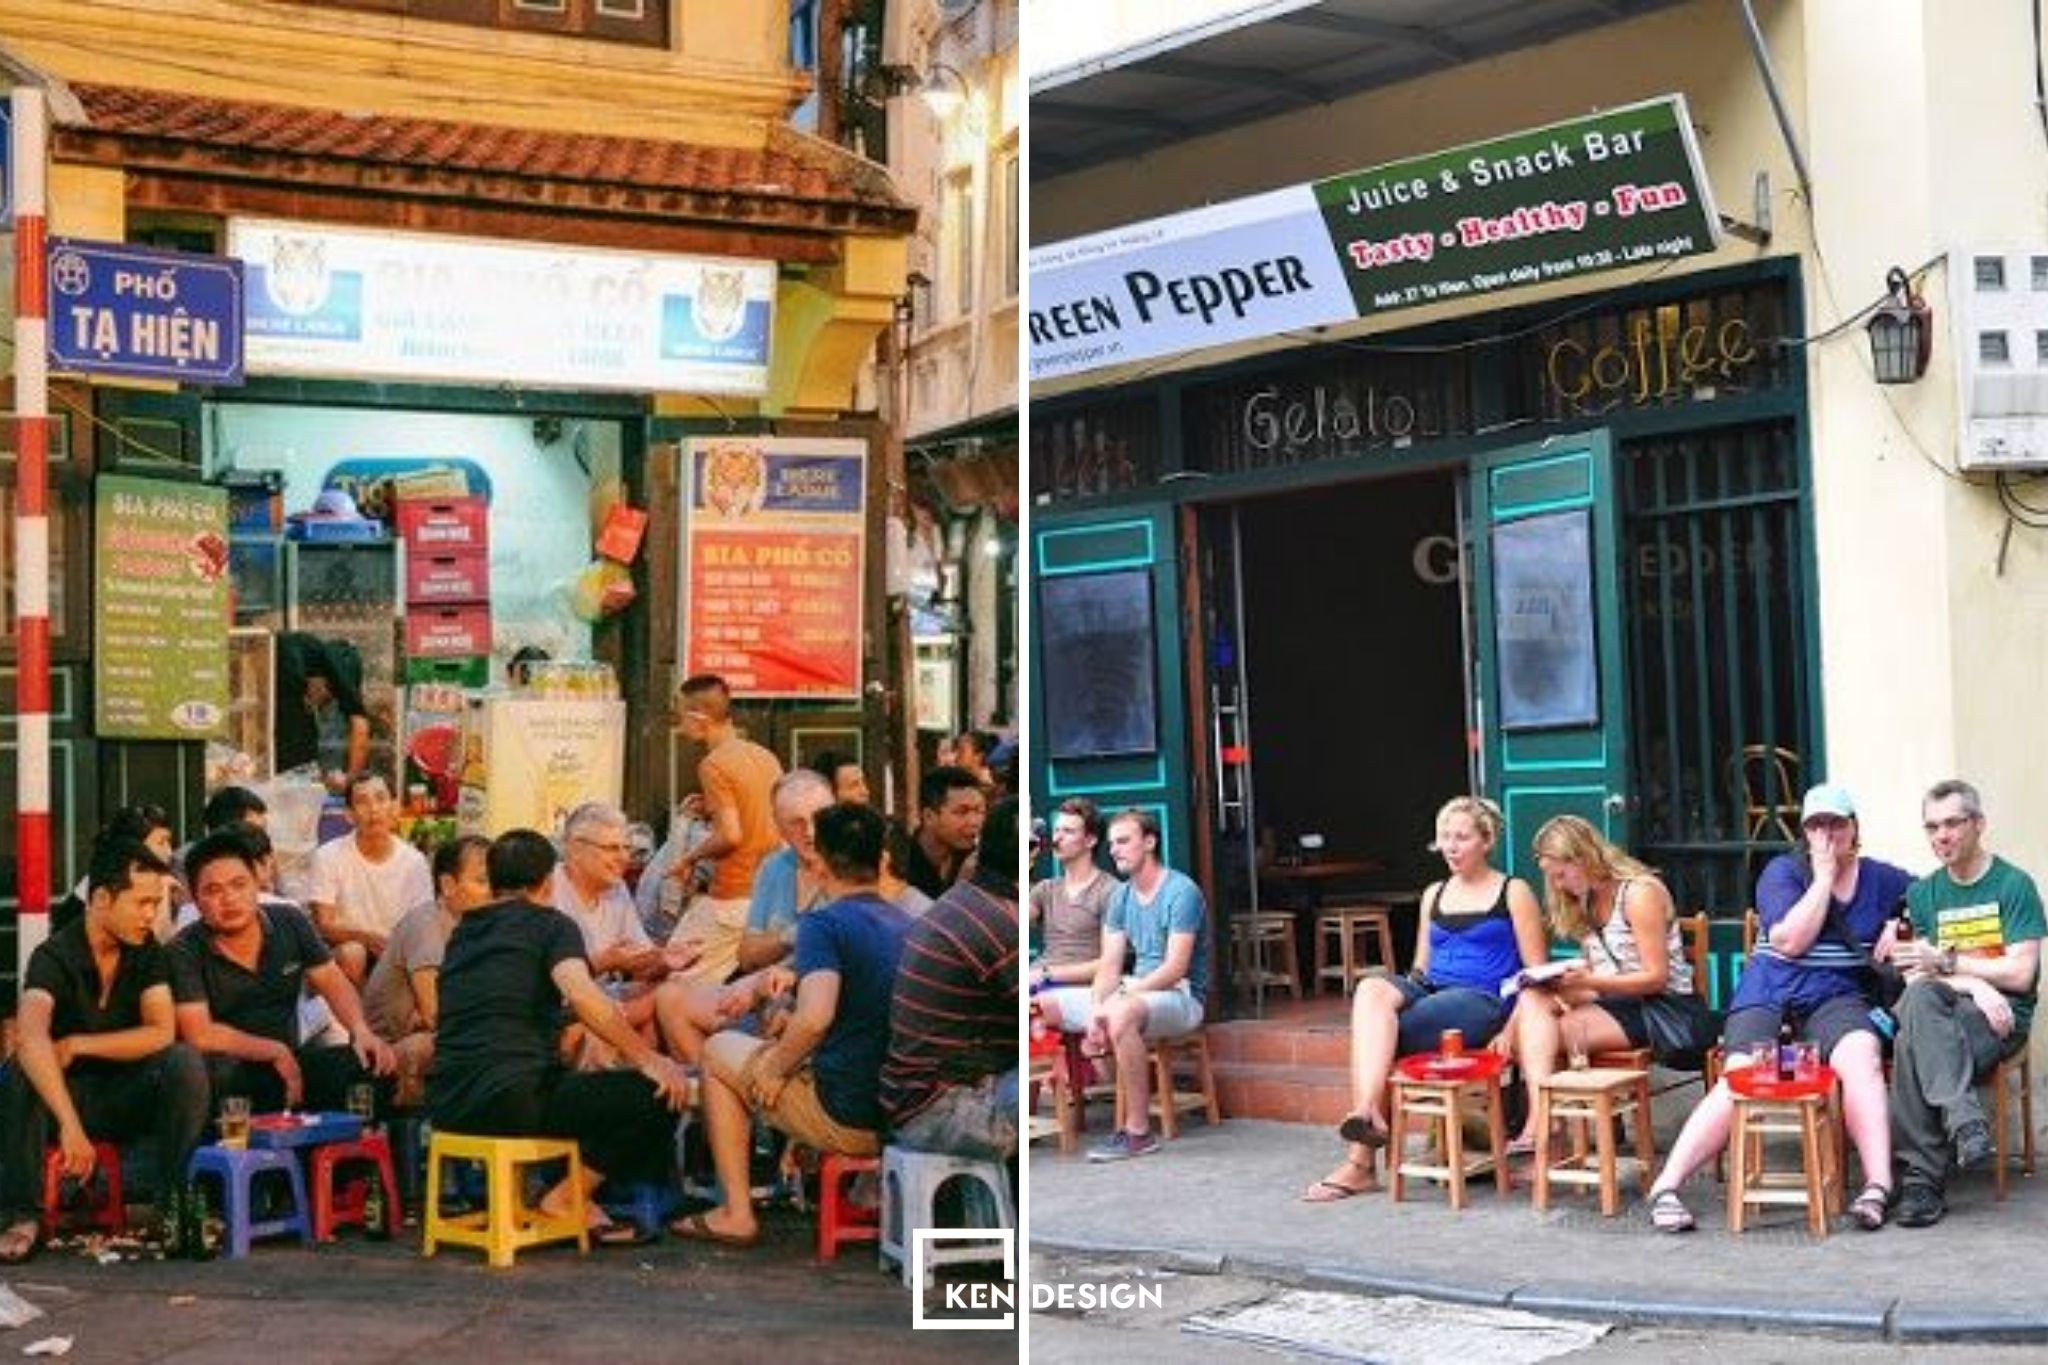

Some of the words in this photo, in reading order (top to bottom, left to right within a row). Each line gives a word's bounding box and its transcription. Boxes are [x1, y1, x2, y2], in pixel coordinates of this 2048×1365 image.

[1347, 179, 1429, 215] Juice
[1440, 169, 1460, 193] &
[1468, 139, 1574, 188] Snack
[1583, 129, 1645, 162] Bar
[1348, 231, 1433, 269] Tasty
[1457, 200, 1587, 247] Healthy
[1612, 181, 1686, 216] Fun
[115, 268, 178, 300] PHỐ
[1471, 272, 1508, 291] Open
[1509, 265, 1540, 284] daily
[1541, 260, 1575, 277] from
[1656, 236, 1693, 256] night
[71, 306, 120, 360] TẠ
[132, 305, 219, 367] HIỆN
[1547, 316, 1757, 405] Coffee
[703, 545, 751, 567] BIA
